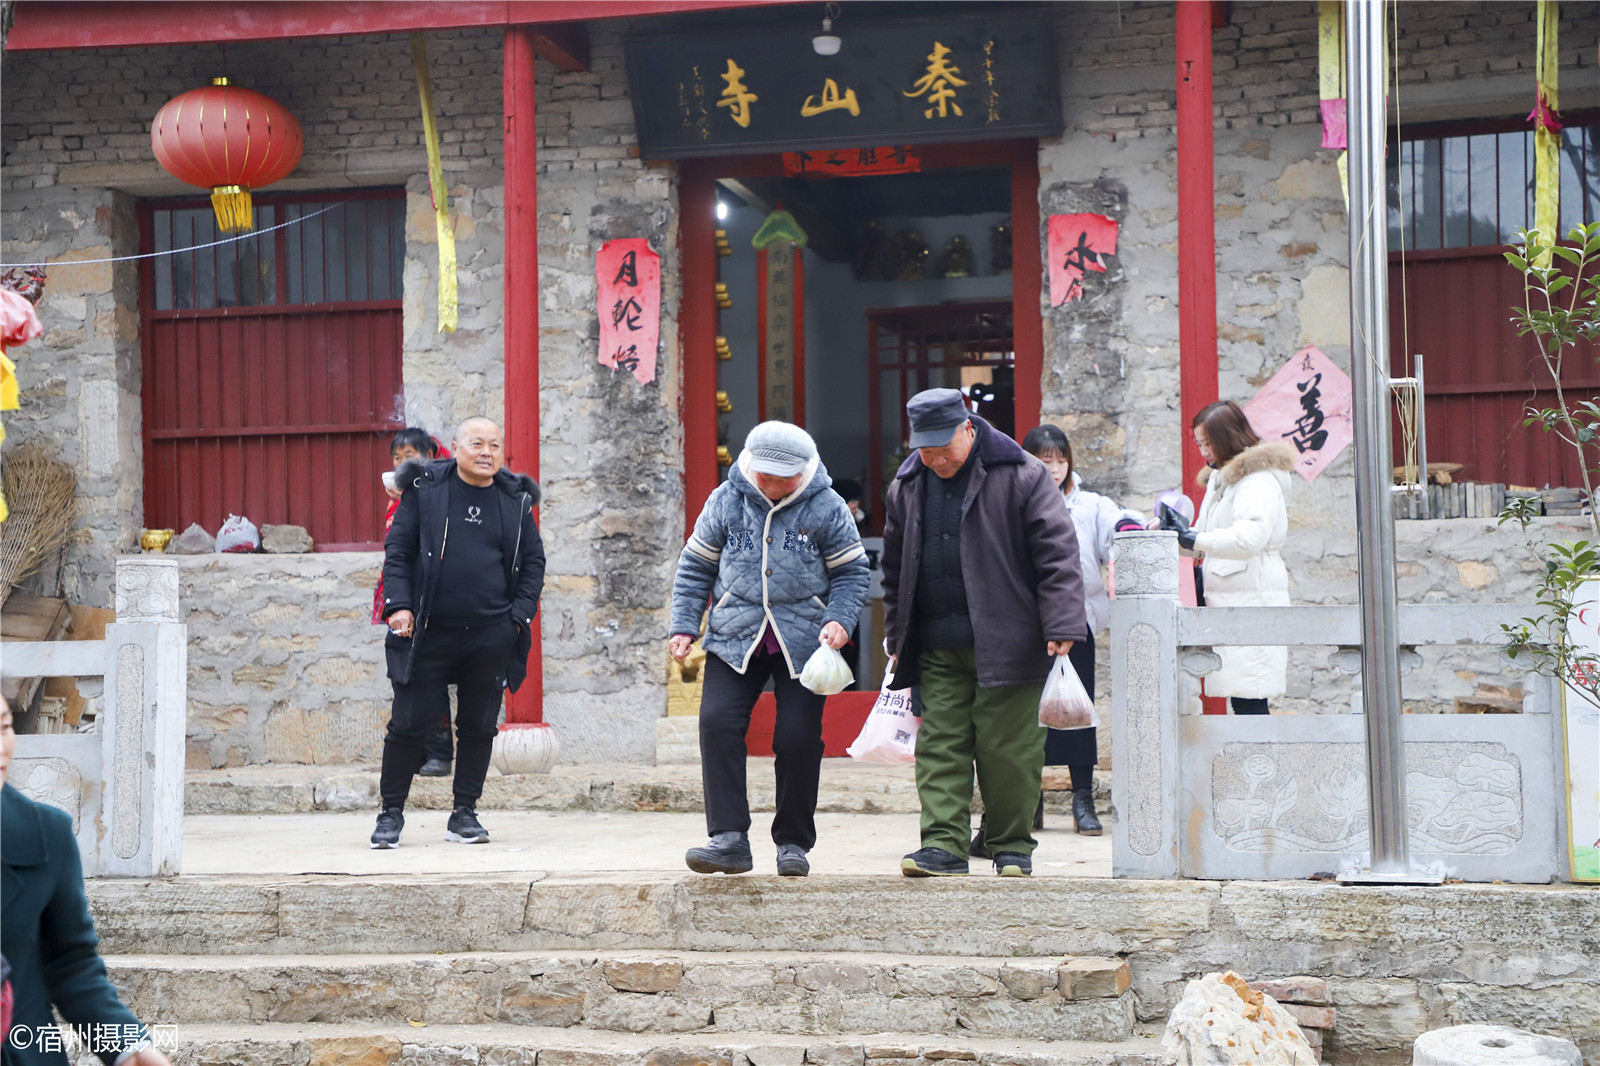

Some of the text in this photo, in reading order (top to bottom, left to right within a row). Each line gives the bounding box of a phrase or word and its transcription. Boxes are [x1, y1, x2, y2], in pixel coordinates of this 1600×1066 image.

[716, 41, 970, 128] 秦山寺
[1281, 372, 1328, 454] 善
